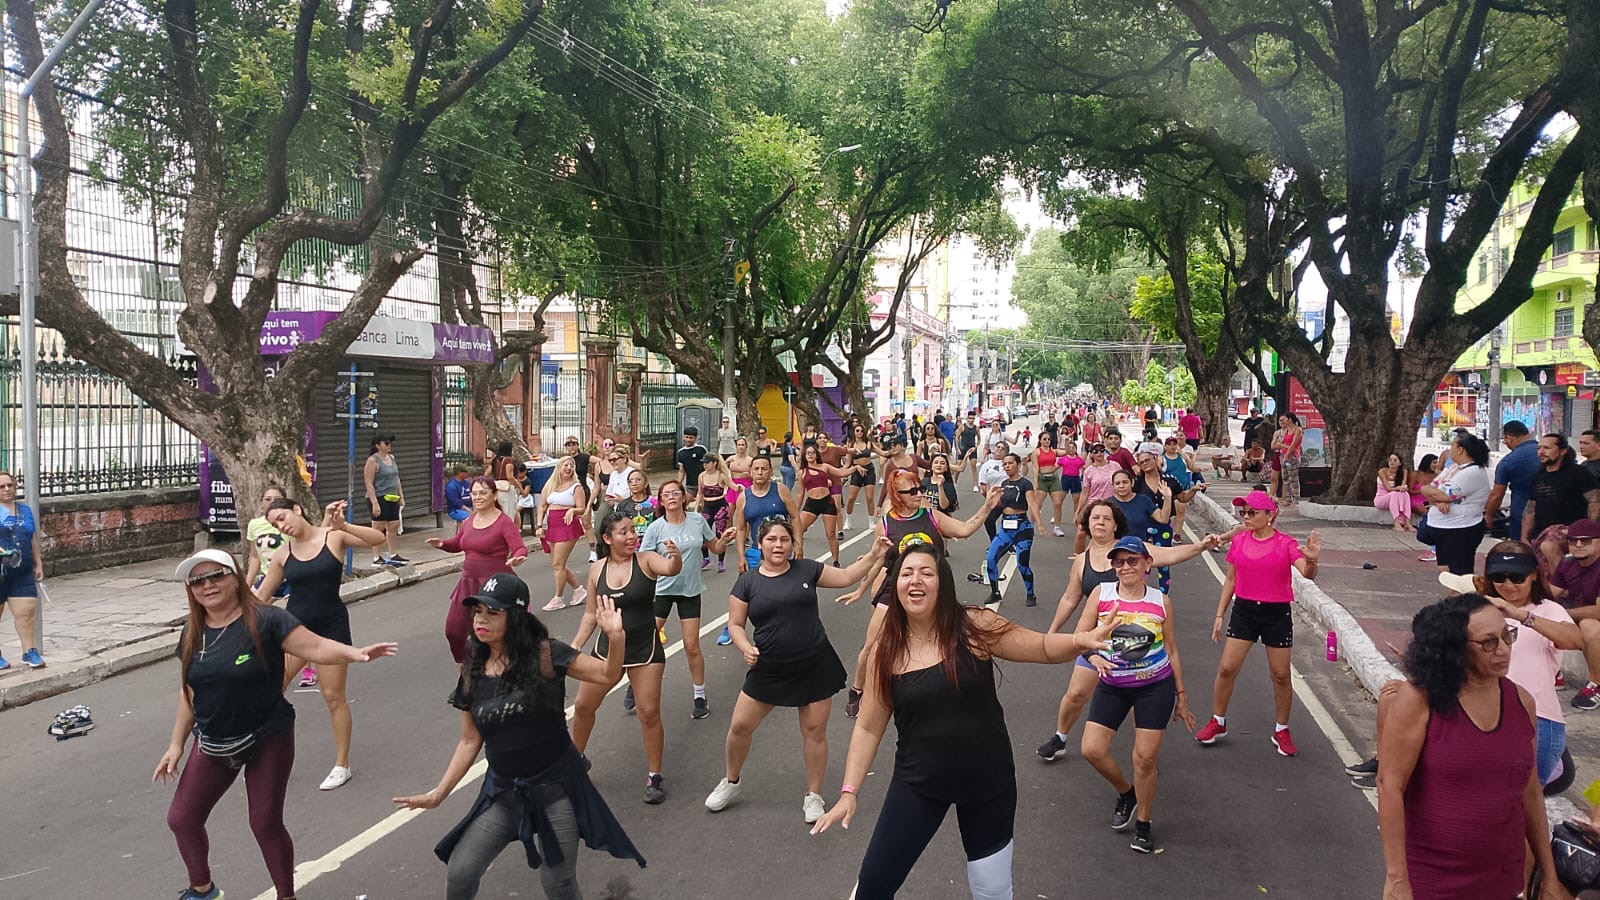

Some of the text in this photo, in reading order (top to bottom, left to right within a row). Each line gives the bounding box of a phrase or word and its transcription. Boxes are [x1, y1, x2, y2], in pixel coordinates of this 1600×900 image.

[262, 318, 299, 330] qui tem
[259, 332, 288, 346] vivo
[395, 330, 419, 346] Lima
[442, 336, 487, 351] Aqui tem vivo
[210, 480, 232, 494] fibr
[483, 578, 498, 592] NY
